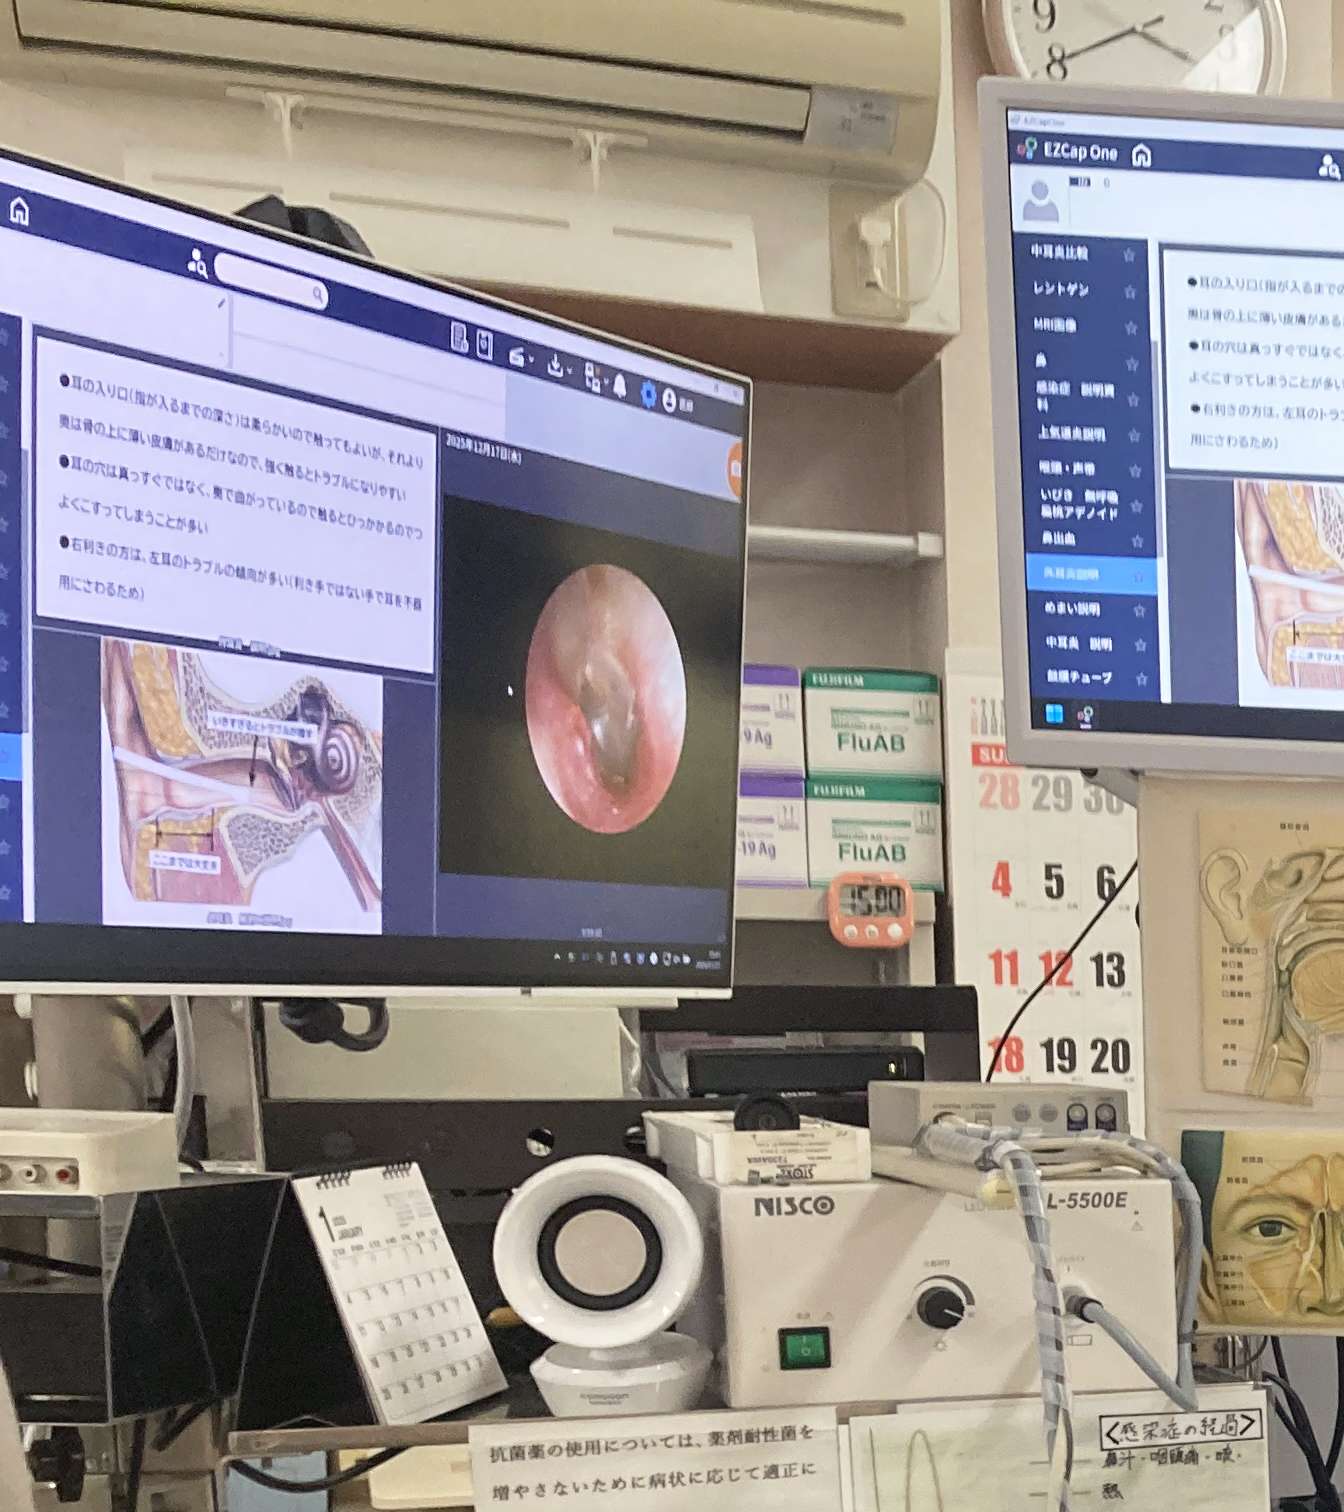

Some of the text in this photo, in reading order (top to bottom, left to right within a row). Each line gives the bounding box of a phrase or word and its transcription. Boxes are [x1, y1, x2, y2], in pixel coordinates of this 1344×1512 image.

[1033, 0, 1056, 33] 9
[1046, 44, 1068, 81] 8
[1043, 141, 1118, 162] EZCap One
[1033, 281, 1089, 297] レントゲン
[812, 673, 864, 687] FUJIFILM
[755, 729, 773, 750] Ag
[837, 732, 905, 752] FluAB
[980, 745, 1006, 763] SU
[814, 785, 865, 798] FUJIFILM
[979, 772, 1021, 810] 28
[1032, 773, 1073, 812] 29
[759, 841, 776, 861] Ag
[838, 842, 906, 862] FluAB
[992, 860, 1117, 901] 4 5 6
[989, 949, 1126, 988] 11 12 13
[988, 1036, 1131, 1074] 18 19 20
[754, 1196, 835, 1217] NISCO
[1046, 1191, 1128, 1209] L-5500E
[490, 1424, 814, 1464] 抗菌薬の使用については、薬剤耐性菌を
[493, 1461, 817, 1501] 増やさないために病状に応じて適正に
